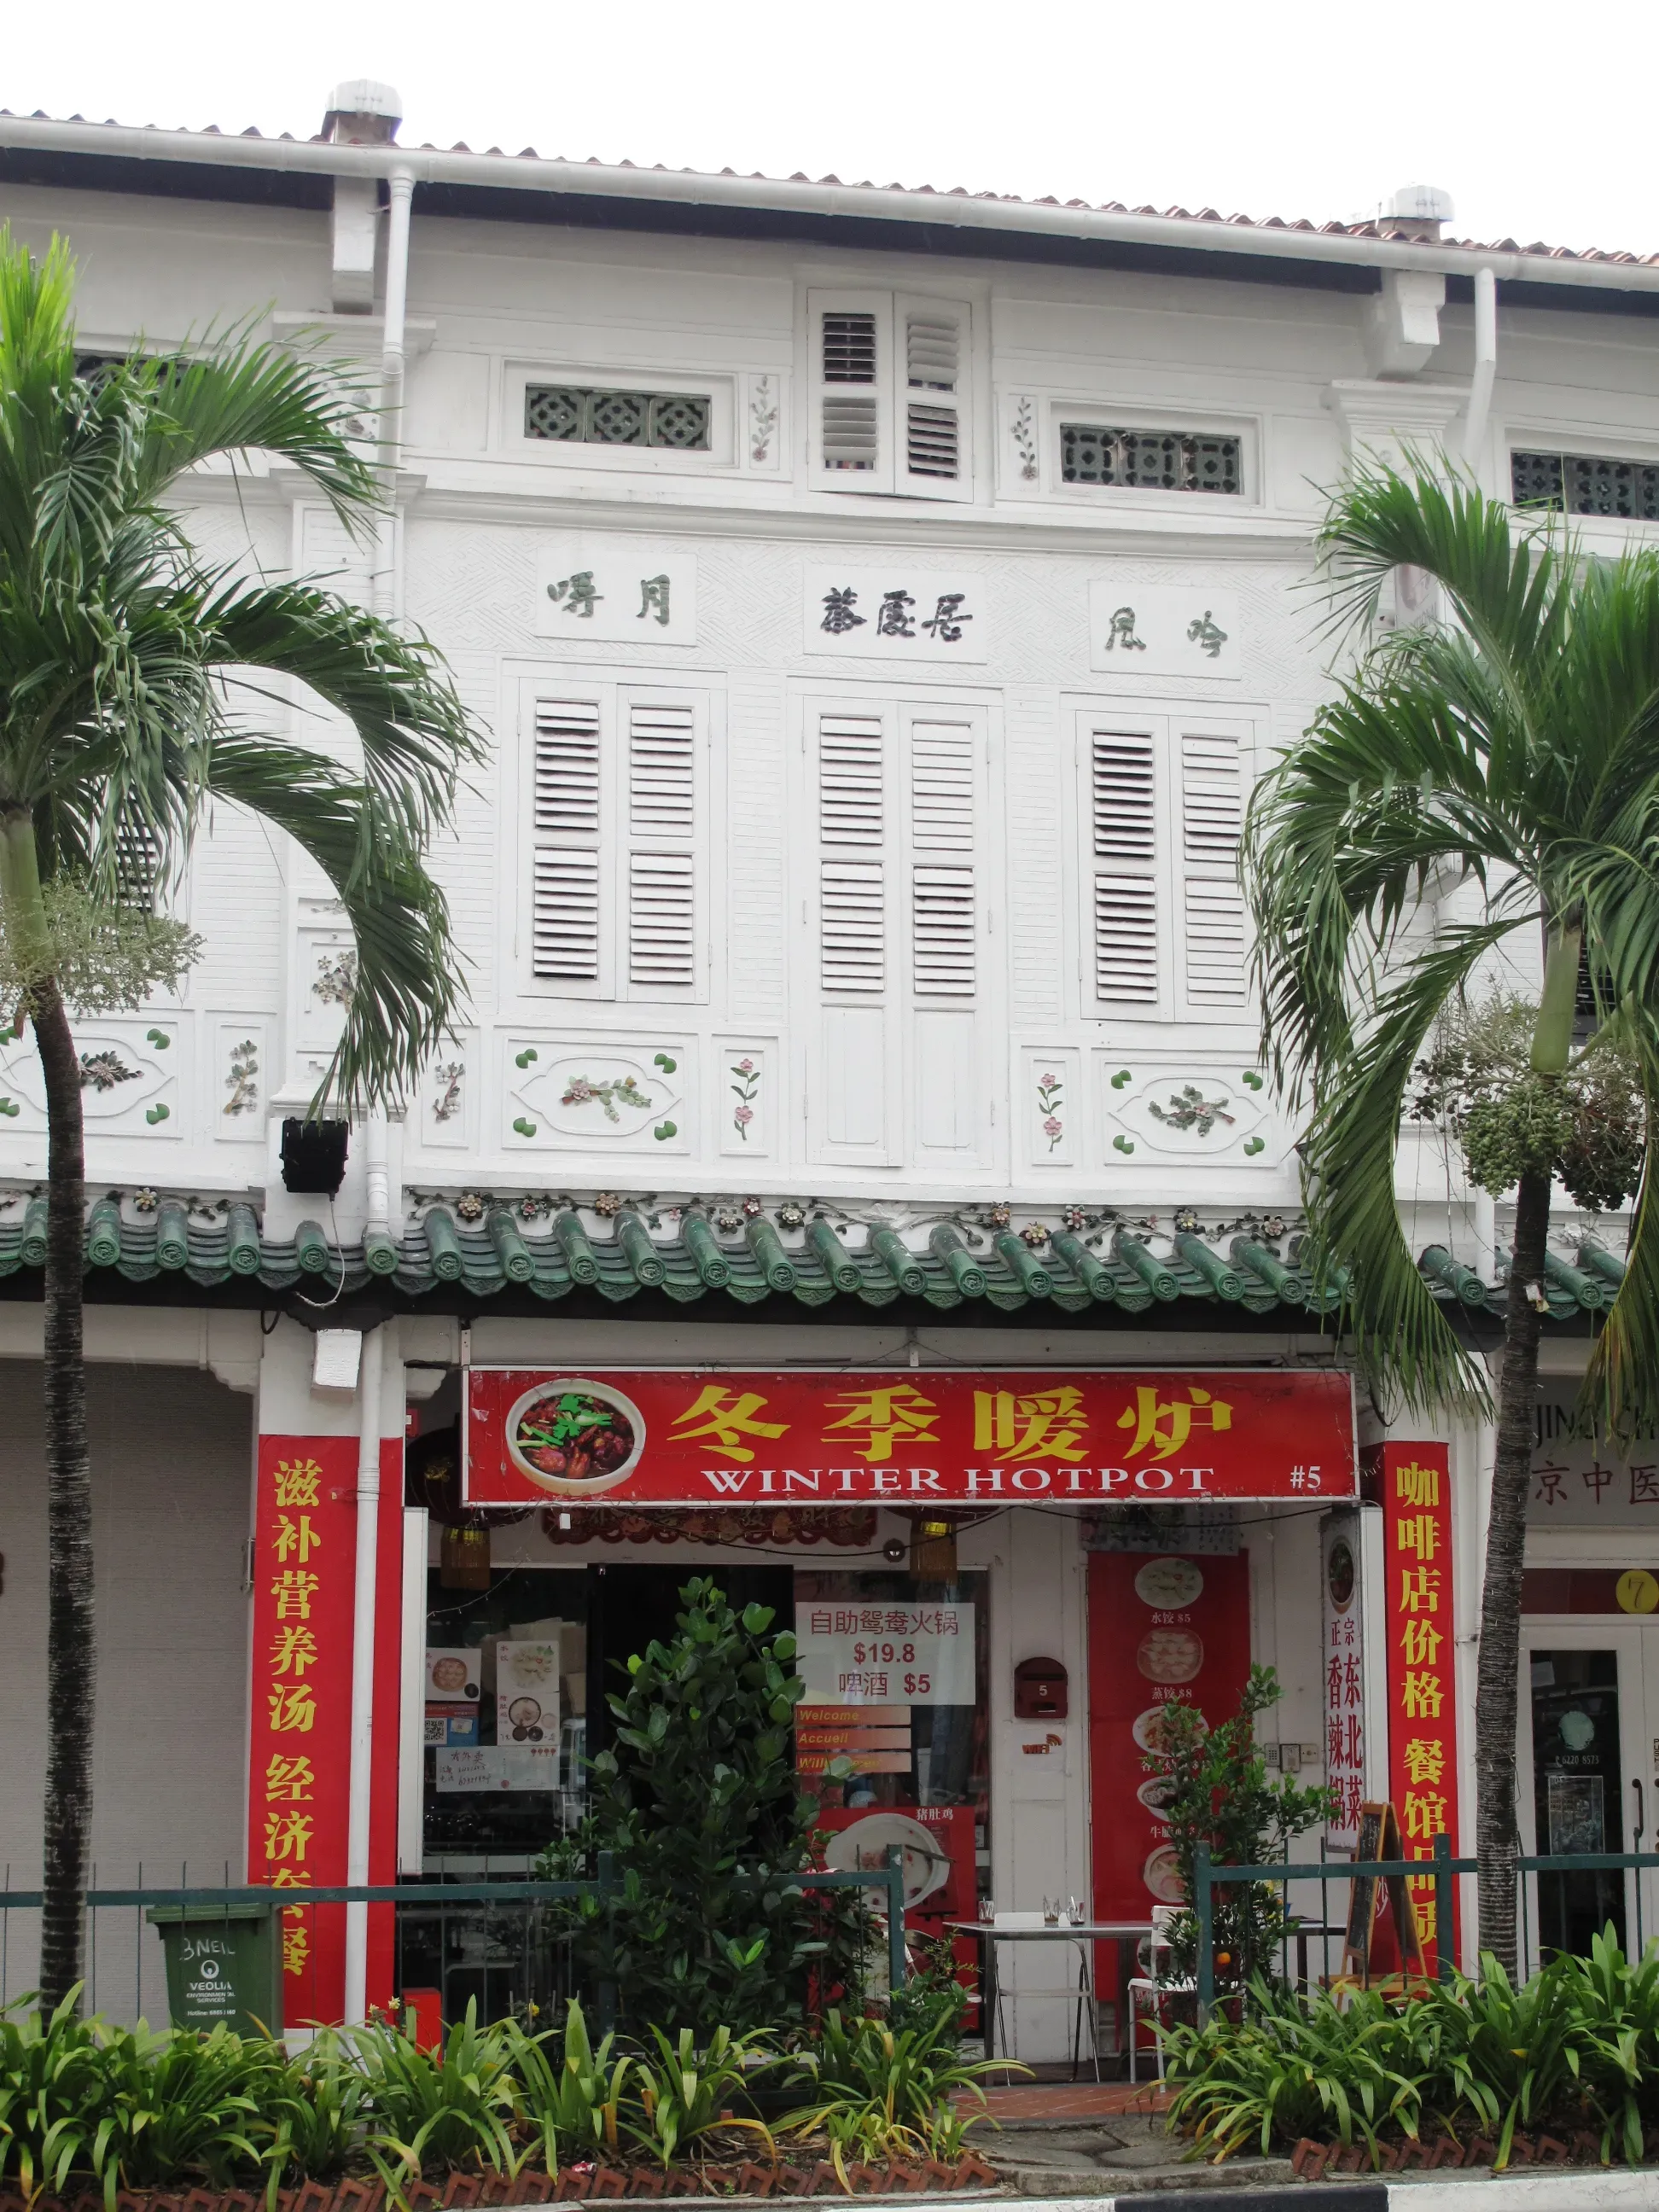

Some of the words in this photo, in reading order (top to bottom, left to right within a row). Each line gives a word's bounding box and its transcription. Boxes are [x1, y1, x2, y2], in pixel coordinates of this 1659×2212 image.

[666, 1384, 1234, 1463] 冬季暖炉
[701, 1468, 947, 1493] WINTER
[963, 1468, 1214, 1491] HOTPOT
[1289, 1464, 1322, 1490] #5
[267, 1458, 323, 1733] 滋补营养汤
[1395, 1461, 1445, 1719] 咖啡店价格
[1627, 1578, 1644, 1610] 7
[811, 1610, 959, 1635] 自助鸳鸯火锅
[1150, 1611, 1174, 1624] 水饺
[853, 1642, 916, 1665] $19.8
[839, 1671, 888, 1697] 啤酒
[903, 1673, 931, 1696] $5
[1039, 1685, 1048, 1697] 5
[799, 1709, 859, 1720] Welcome
[798, 1732, 849, 1744] Accueil
[1562, 1755, 1579, 1765] 6220
[1581, 1755, 1599, 1765] 8573
[916, 1807, 955, 1821] 猪肚鸡
[189, 1981, 232, 1991] VEOLIA
